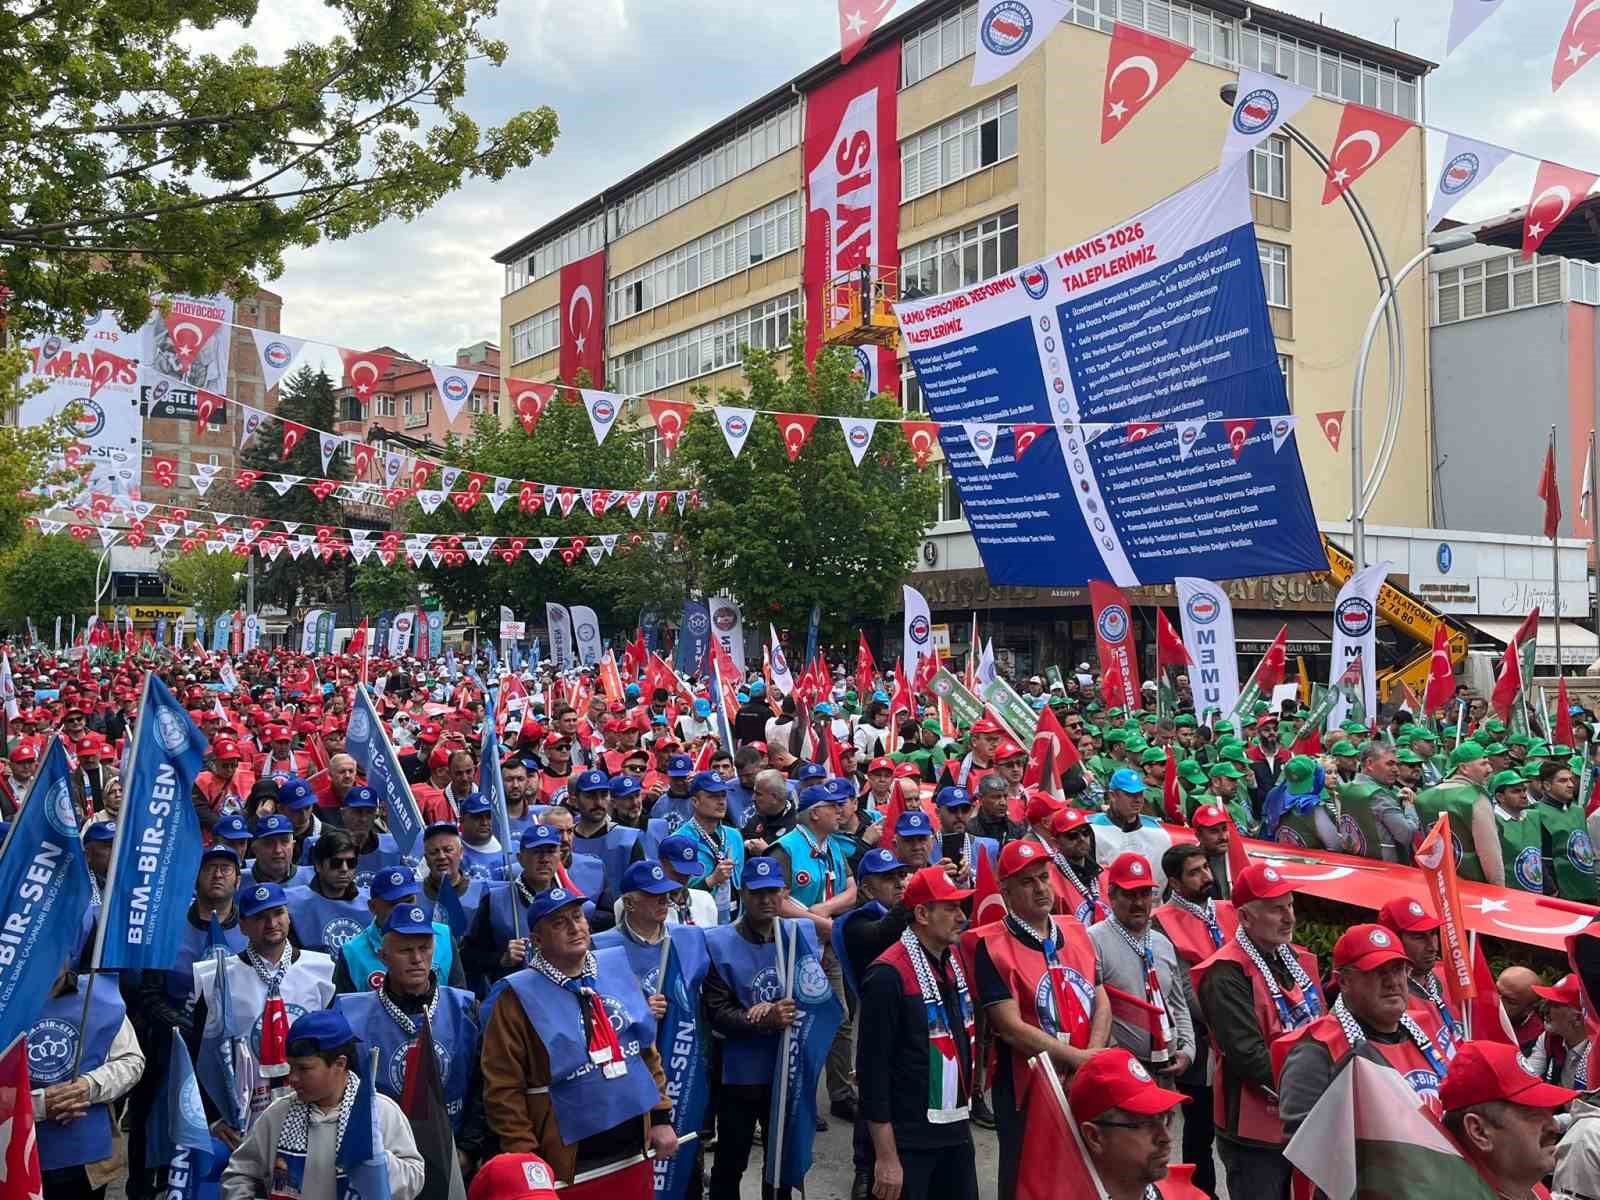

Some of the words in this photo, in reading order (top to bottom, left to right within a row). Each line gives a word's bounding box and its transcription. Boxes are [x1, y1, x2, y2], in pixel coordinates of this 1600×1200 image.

[1056, 256, 1063, 269] 1
[1063, 240, 1106, 268] MAYIS
[1108, 222, 1144, 250] 2026
[1062, 244, 1157, 292] TALEPLERİMİZ
[926, 295, 970, 319] PERSONEL
[970, 276, 1016, 304] REFORMU
[1395, 596, 1432, 624] PLATFORM
[1401, 612, 1414, 625] 80
[128, 763, 176, 944] BEM-BİR-SEN
